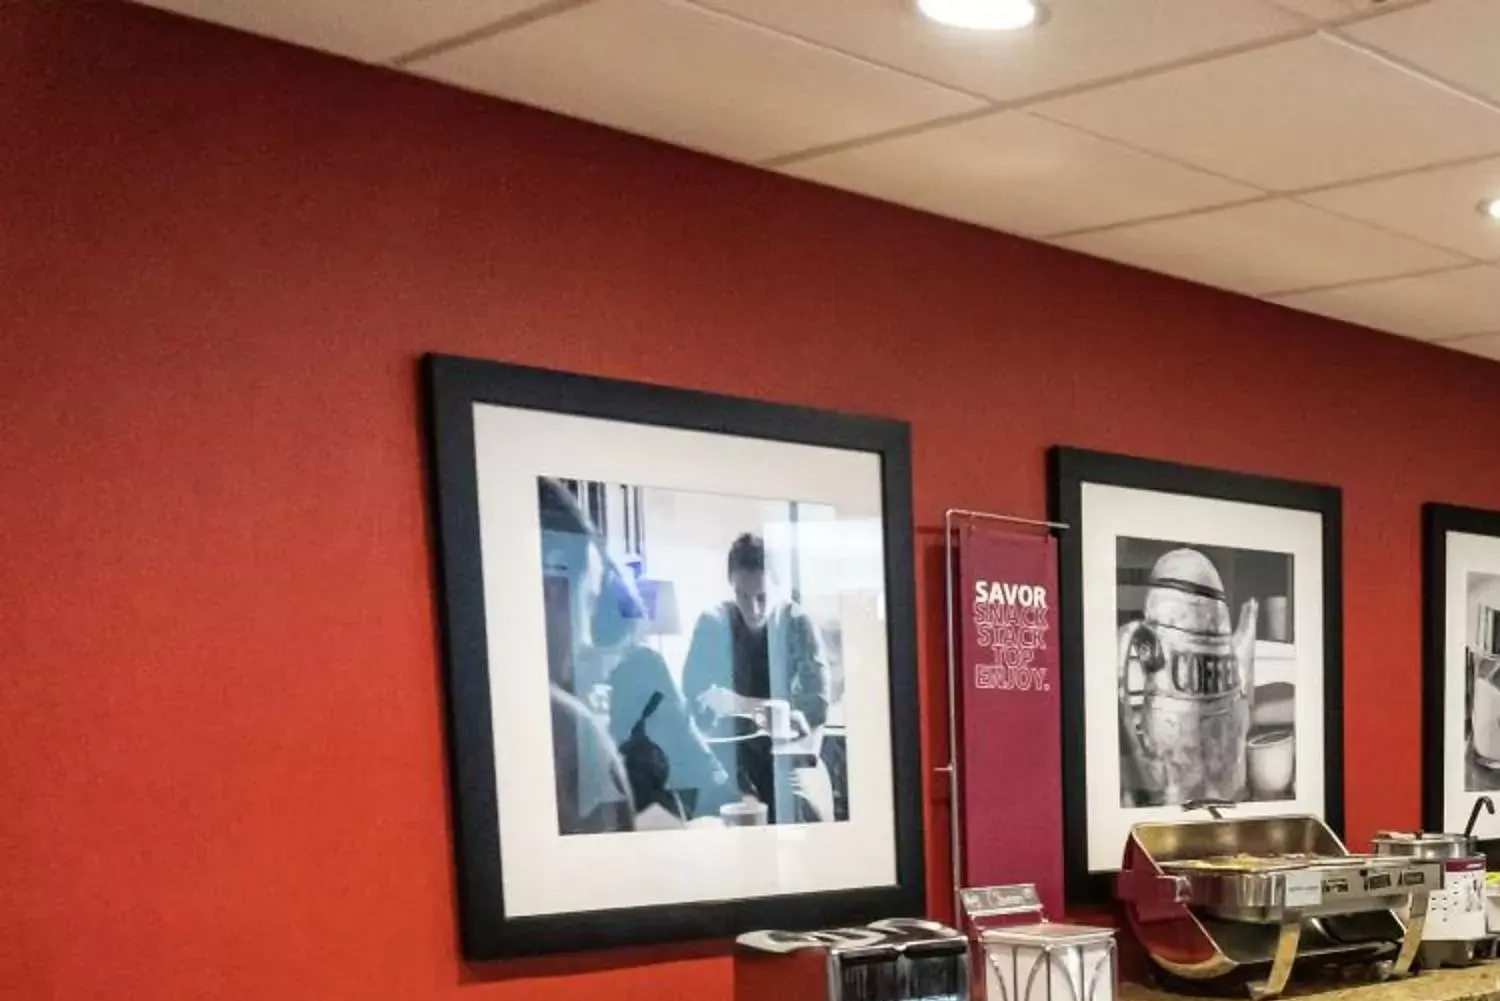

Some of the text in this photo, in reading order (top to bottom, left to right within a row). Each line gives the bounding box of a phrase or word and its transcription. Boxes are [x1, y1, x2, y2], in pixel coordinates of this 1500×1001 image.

[975, 580, 1047, 608] SAVOR
[973, 601, 1048, 629] SNACK
[977, 622, 1048, 650] STACK
[991, 644, 1035, 667] TOP
[975, 664, 1051, 691] ENJOY.
